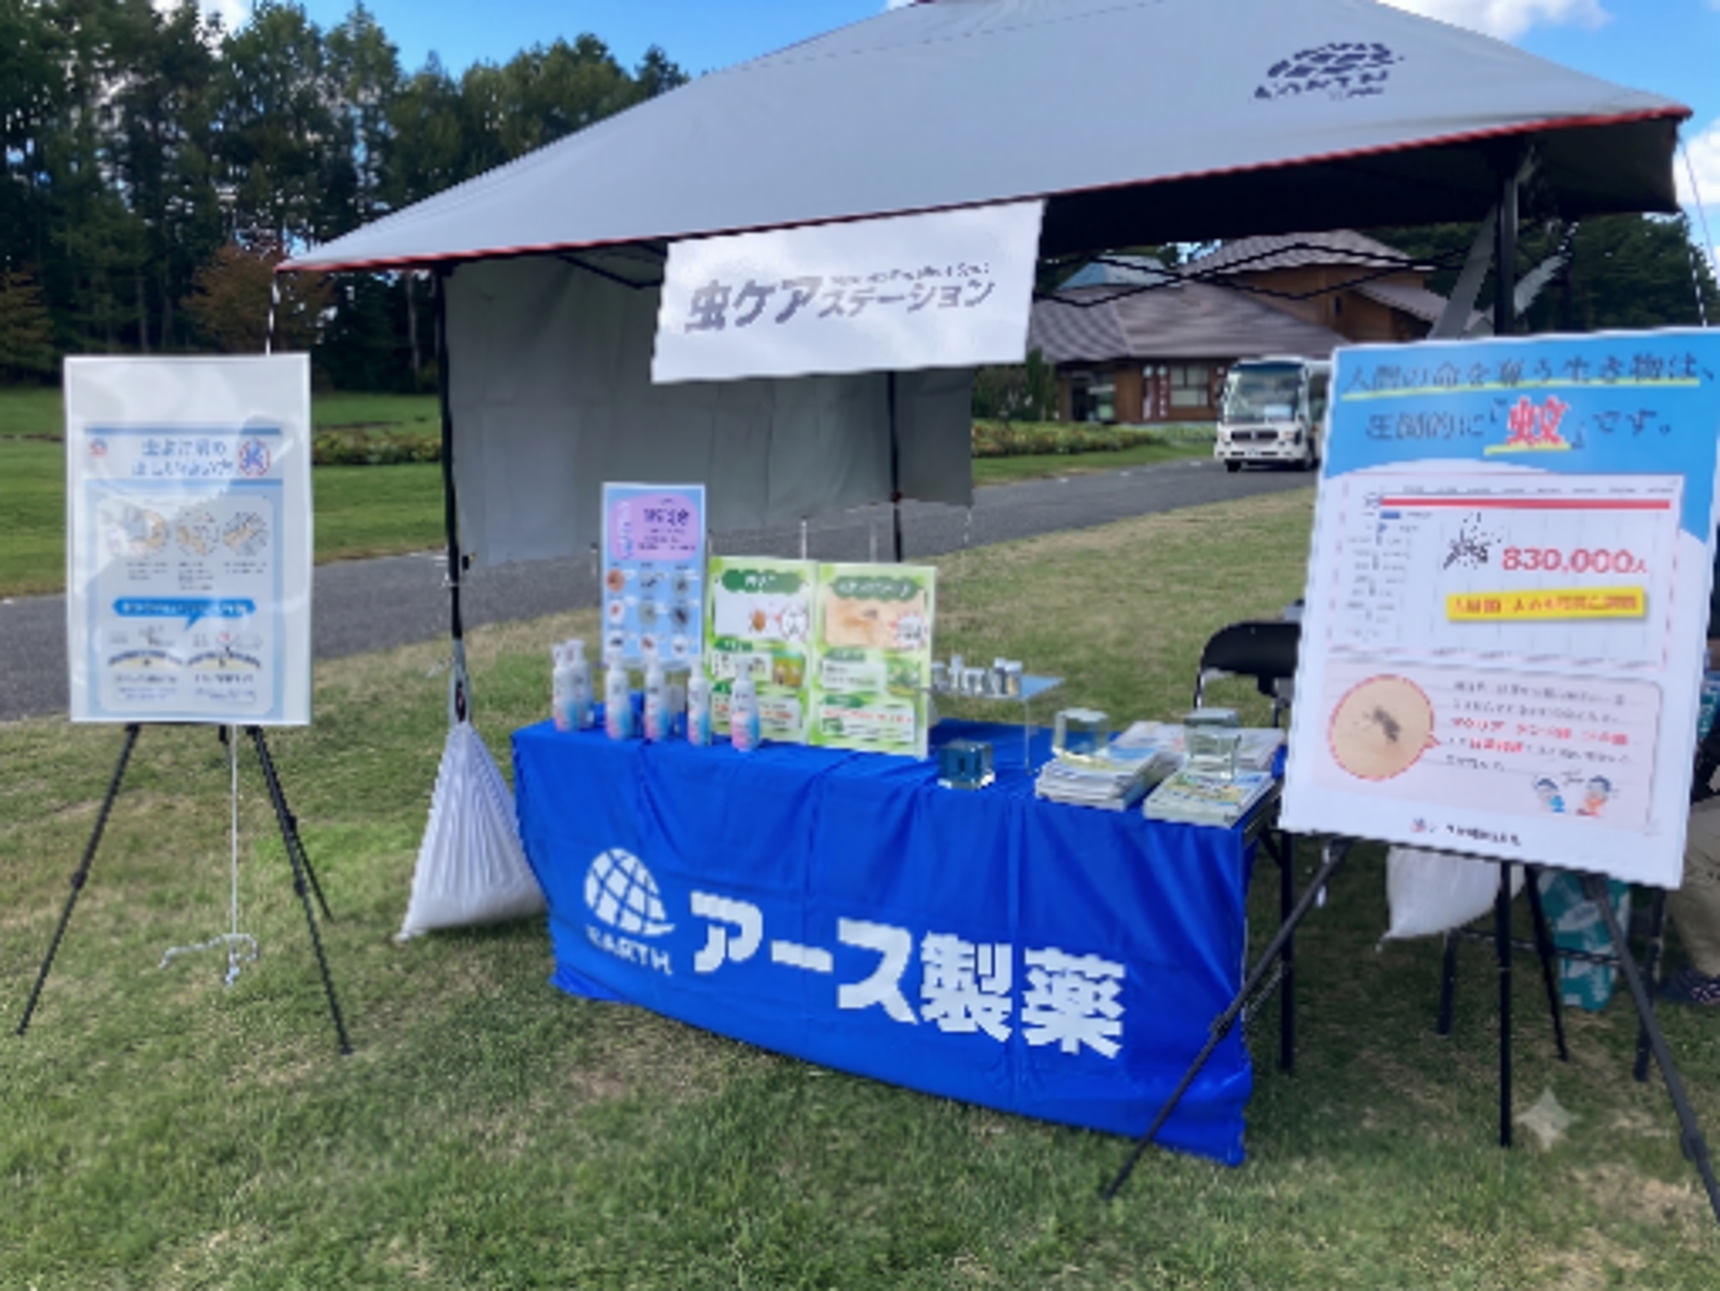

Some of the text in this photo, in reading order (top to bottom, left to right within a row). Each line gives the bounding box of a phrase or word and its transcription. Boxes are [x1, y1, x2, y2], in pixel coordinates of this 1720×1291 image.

[684, 277, 996, 333] 虫ケアステーション
[689, 889, 1127, 1059] アース製薬
